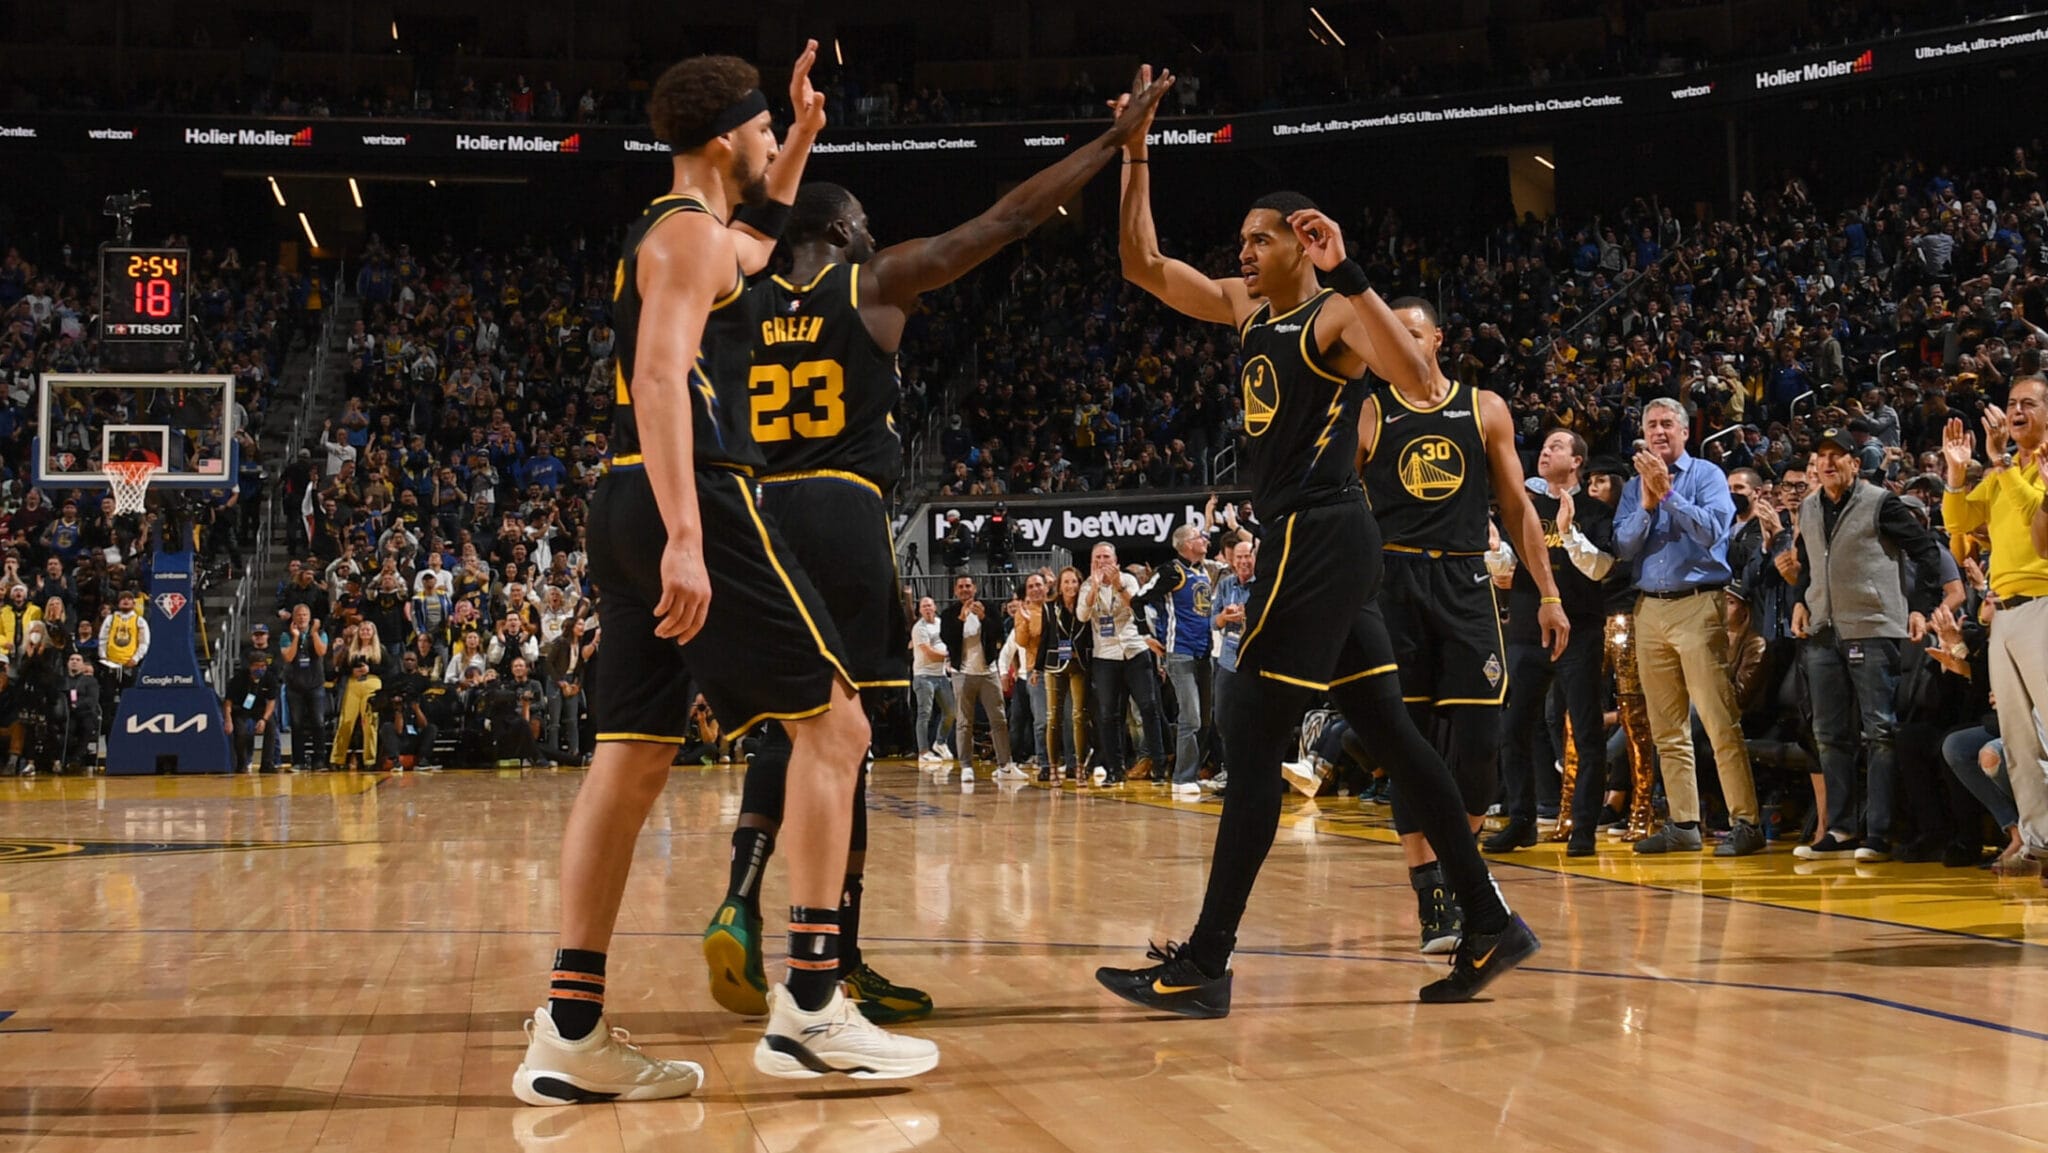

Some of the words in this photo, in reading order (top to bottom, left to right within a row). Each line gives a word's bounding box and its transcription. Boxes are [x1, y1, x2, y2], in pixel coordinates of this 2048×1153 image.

[1915, 41, 1970, 59] Ultra-fast,
[1971, 28, 2048, 50] ultra-powerfu
[1756, 70, 1802, 88] Holier
[1803, 60, 1852, 80] Molier
[1671, 85, 1711, 99] verizon
[1273, 122, 1324, 135] Ultra-fast,
[1324, 114, 1399, 130] ultra-powerful
[1399, 113, 1415, 123] 5G
[1416, 111, 1443, 122] Ultra
[1443, 105, 1498, 119] Wideband
[1499, 104, 1509, 115] is
[1509, 104, 1535, 114] here
[1535, 100, 1547, 112] in
[1546, 99, 1582, 111] Chase
[1582, 95, 1623, 107] Center.
[88, 129, 133, 140] verizon
[185, 128, 237, 144] Holier
[238, 130, 292, 145] Molier
[362, 135, 406, 145] verizon
[456, 135, 507, 151] Holier
[508, 136, 560, 151] Molier
[1024, 135, 1065, 146] verizon
[1163, 129, 1214, 145] Molier
[811, 141, 855, 153] ideband
[856, 141, 866, 152] is
[866, 141, 892, 152] here
[892, 140, 902, 151] in
[902, 140, 938, 150] Chase
[937, 138, 977, 149] Center.
[128, 255, 178, 277] 2:54
[135, 279, 171, 317] 18
[129, 324, 183, 335] TISSOT
[762, 316, 824, 346] GREEN
[748, 359, 846, 443] 23
[1422, 441, 1451, 461] 30
[1063, 511, 1175, 543] betway
[142, 675, 173, 686] Google
[173, 675, 194, 684] Pixel
